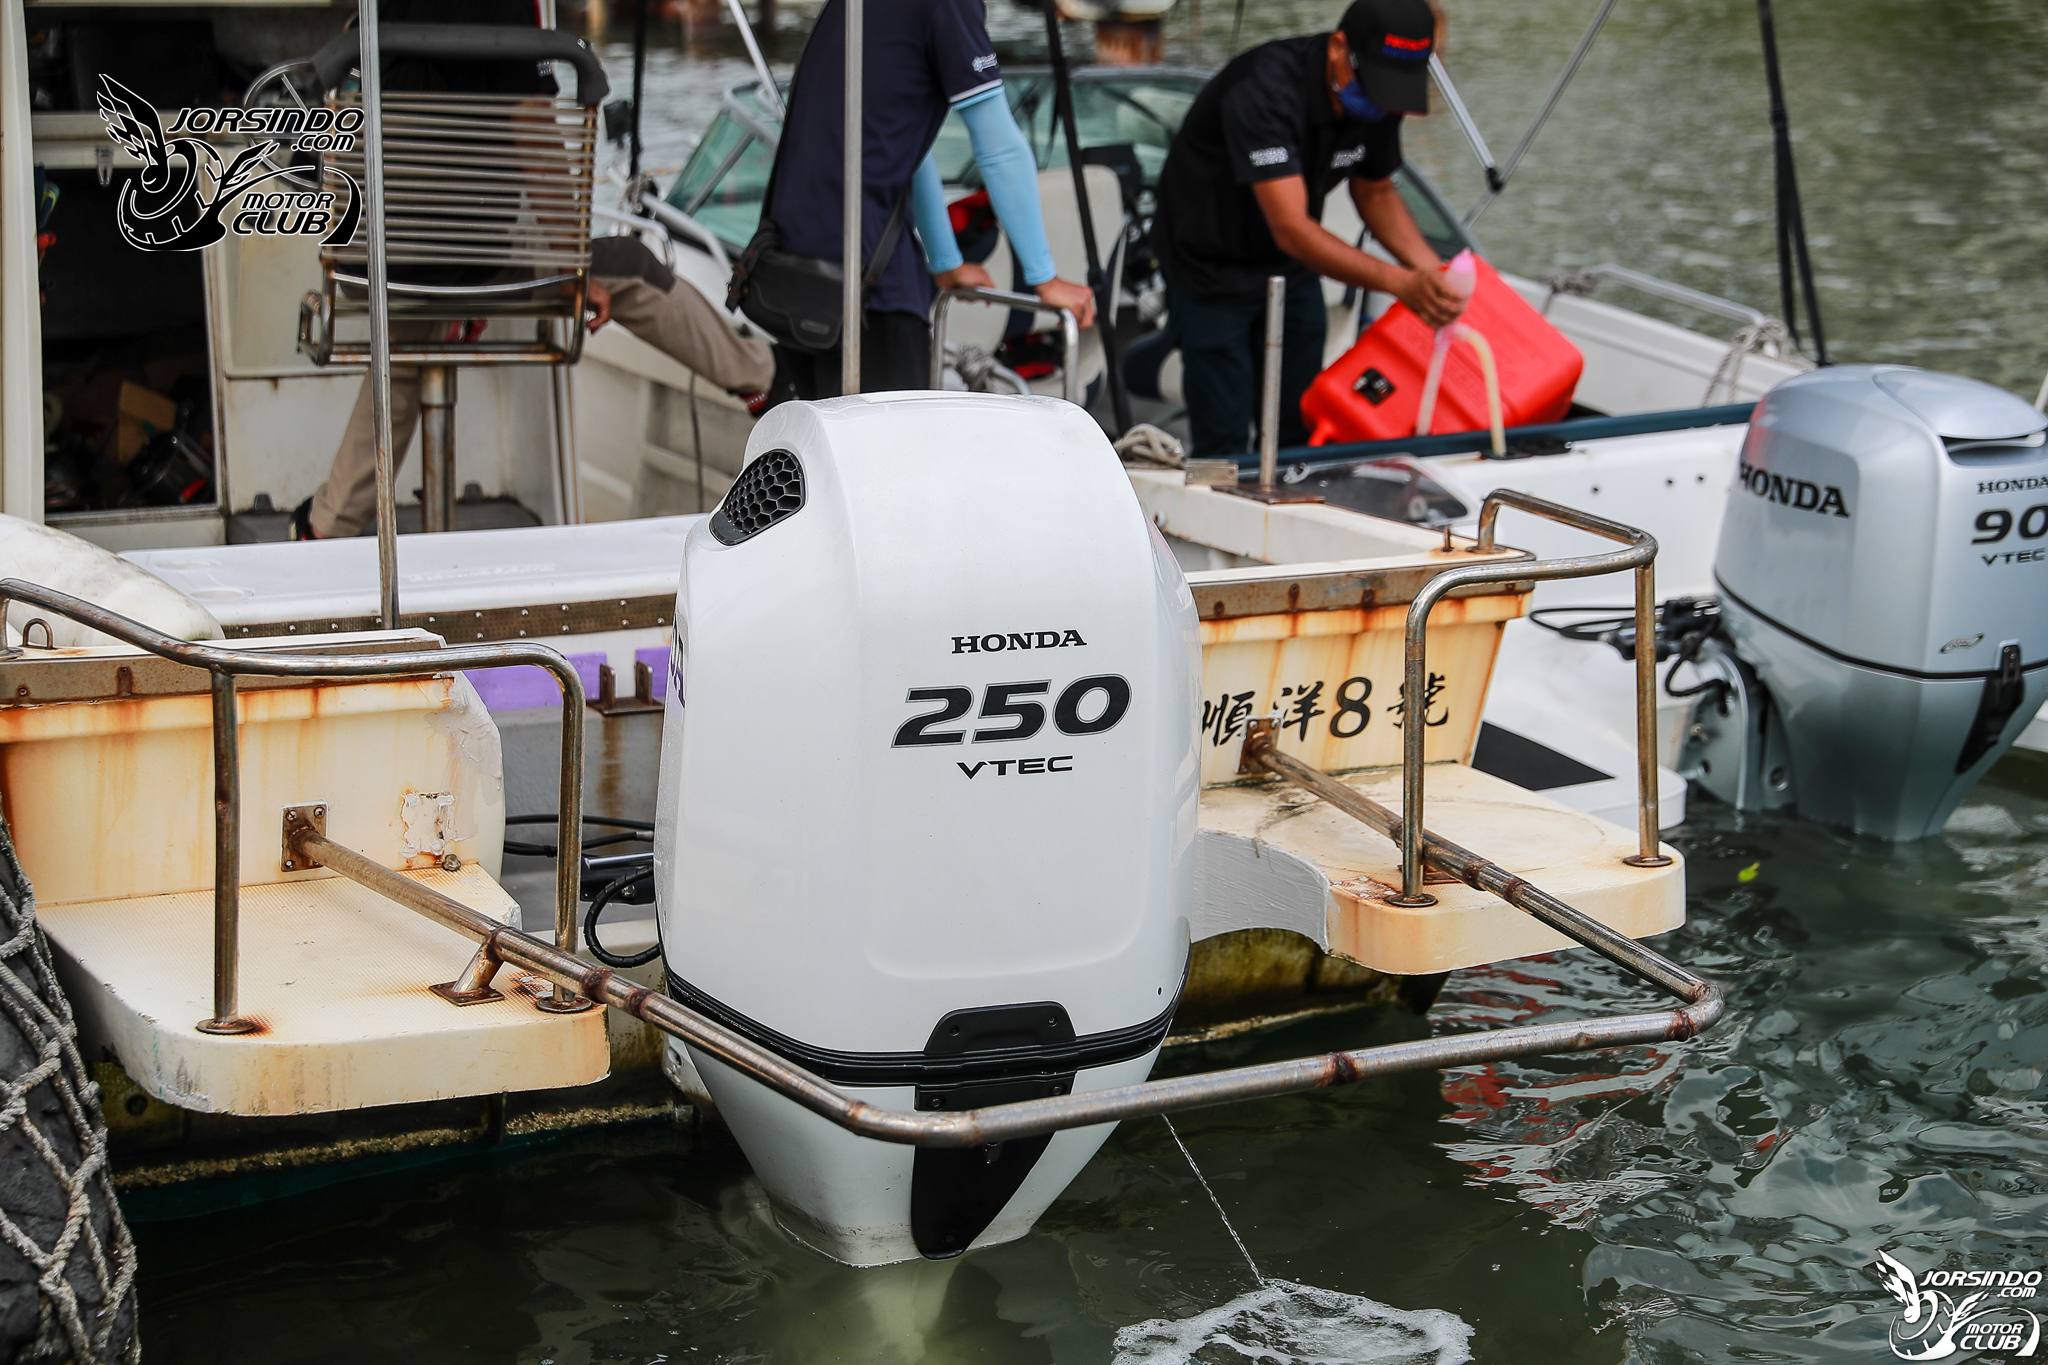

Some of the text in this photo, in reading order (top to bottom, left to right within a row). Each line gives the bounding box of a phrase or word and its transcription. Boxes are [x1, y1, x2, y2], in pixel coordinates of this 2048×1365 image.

[1971, 503, 2048, 546] 90
[1981, 548, 2046, 567] VTEC
[951, 629, 1087, 654] HONDA
[890, 673, 1133, 748] 250
[956, 755, 1073, 780] VTEC
